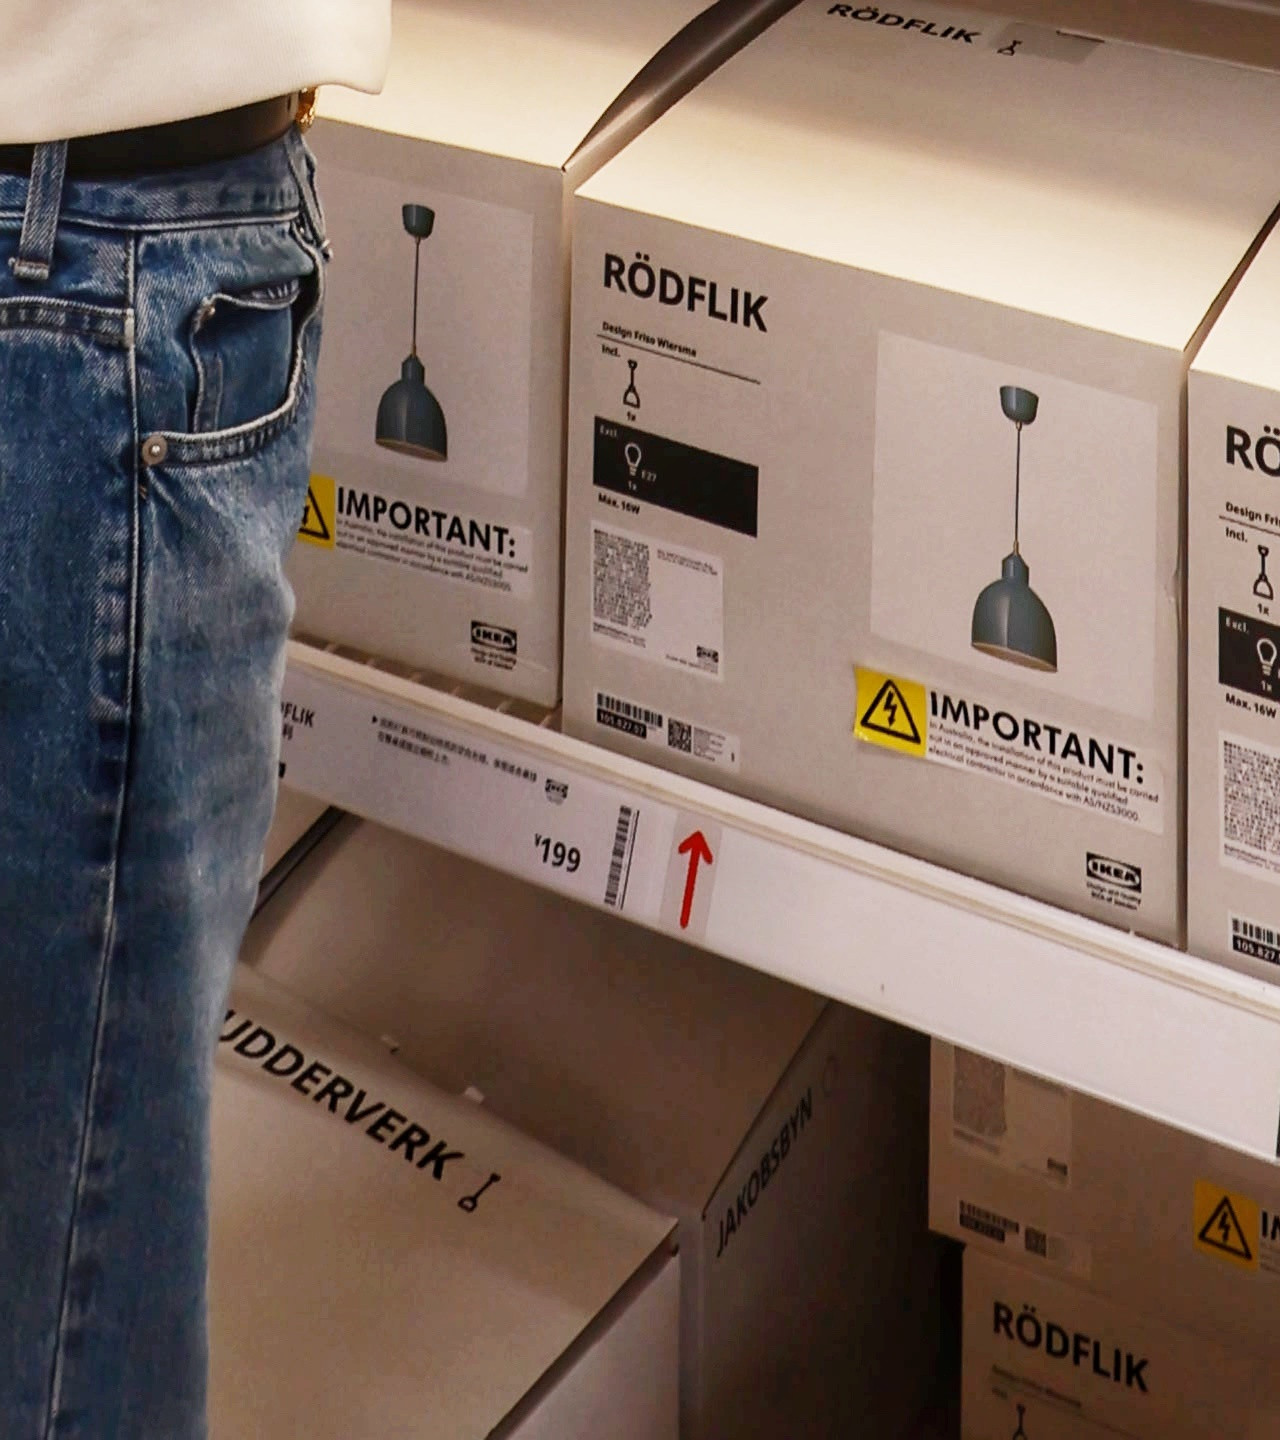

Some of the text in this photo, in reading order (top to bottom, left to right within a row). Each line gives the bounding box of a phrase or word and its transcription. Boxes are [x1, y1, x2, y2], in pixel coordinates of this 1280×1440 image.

[826, 1, 984, 47] RÖDFLIK
[602, 251, 769, 333] RÖDFLIK
[601, 344, 621, 358] Incl.
[602, 320, 697, 358] Design Friso Wiersma
[337, 486, 516, 559] IMPORTANT:
[1225, 501, 1263, 522] Design
[1225, 527, 1248, 543] Incl.
[1257, 603, 1270, 616] 1x
[1225, 692, 1278, 720] Max. 16W
[930, 691, 1145, 784] IMPORTANT:
[534, 832, 582, 874] ¥199
[717, 1088, 813, 1258] JAKOBSBYN
[991, 1300, 1151, 1394] RÖDFLIK
